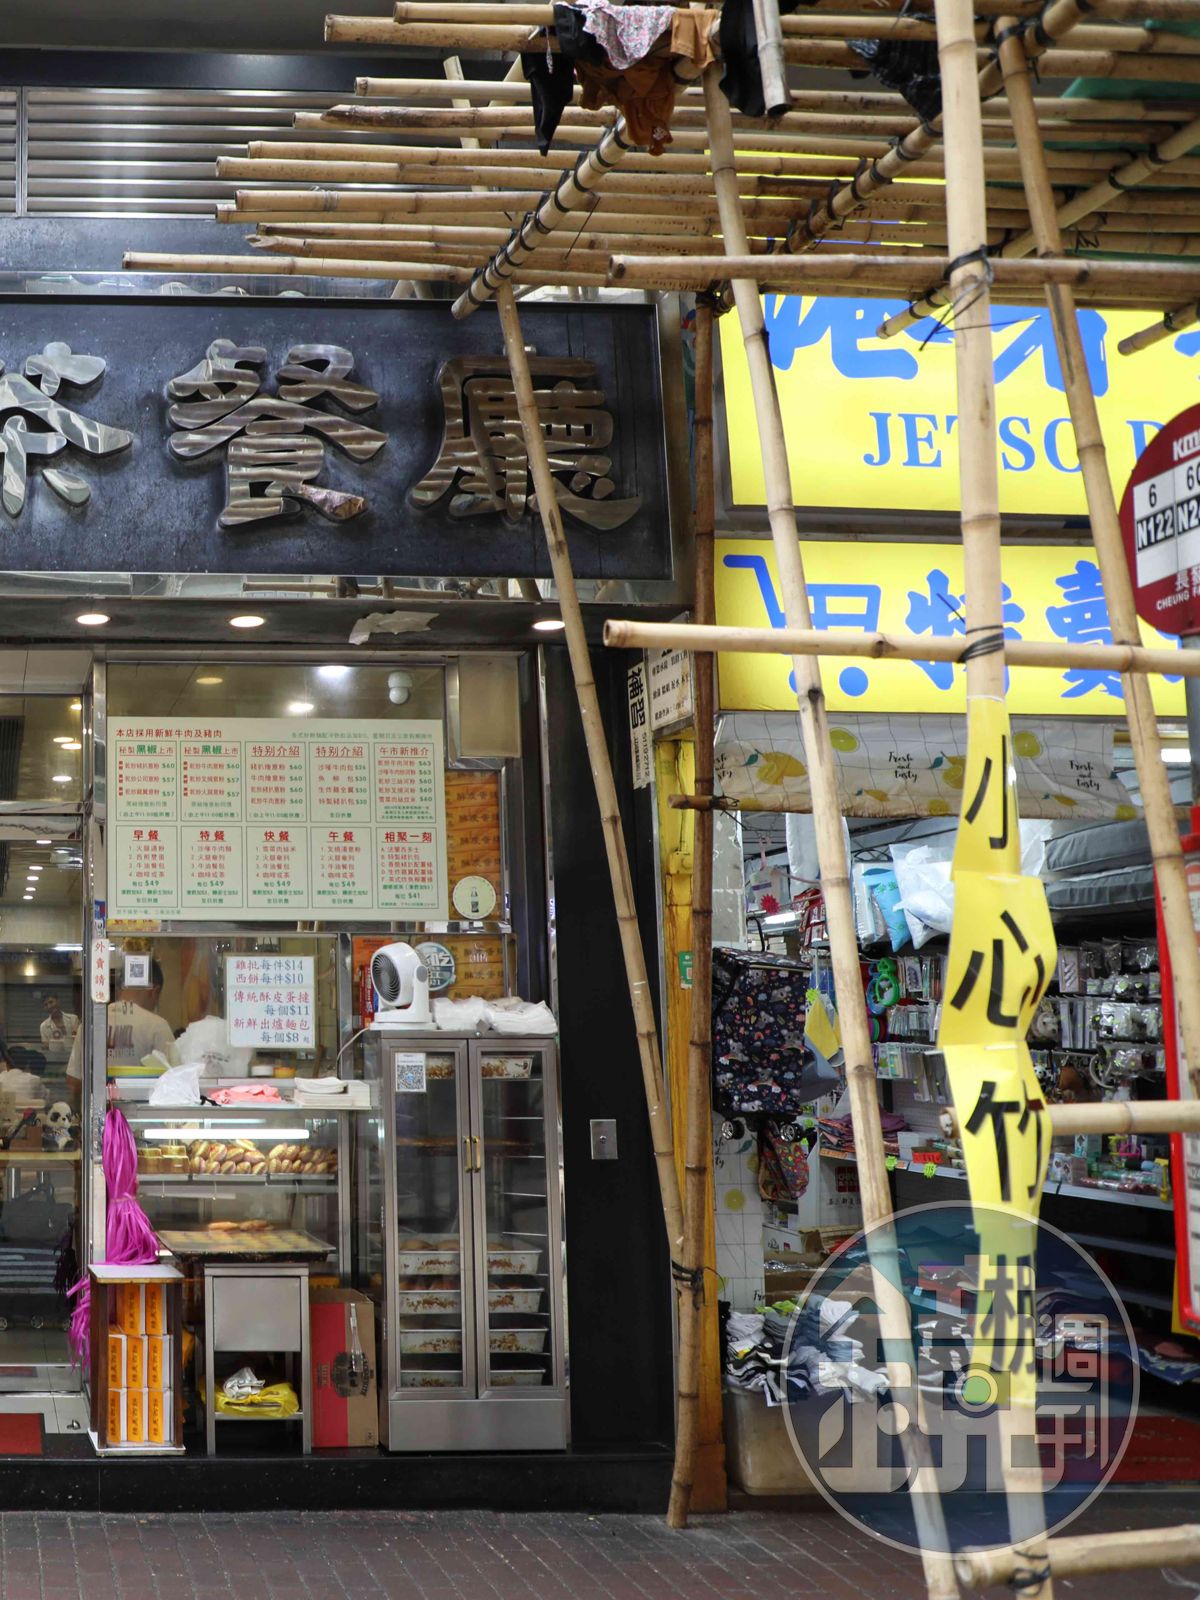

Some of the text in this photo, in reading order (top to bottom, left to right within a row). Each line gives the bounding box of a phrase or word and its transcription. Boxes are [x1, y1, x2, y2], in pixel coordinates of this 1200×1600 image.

[863, 411, 1084, 474] JESO
[1148, 483, 1157, 508] 6
[1136, 510, 1175, 548] N122
[1156, 591, 1190, 612] CHEUNG
[627, 668, 646, 730] 補習
[116, 728, 222, 738] 本店採用新鮮牛肉及豬肉
[888, 751, 914, 763] Fresh
[1069, 759, 1094, 772] Fresh
[894, 769, 918, 782] tasty
[1075, 777, 1101, 791] tasty
[133, 830, 159, 841] 早餐
[200, 830, 225, 841] 特餐
[264, 831, 289, 841] 快餐
[328, 831, 354, 841] 午餐
[385, 831, 432, 843] 相聚一刻
[235, 973, 304, 985] 西餅每件$10
[263, 1005, 310, 1016] 每個$11
[260, 1032, 300, 1044] 每個$8
